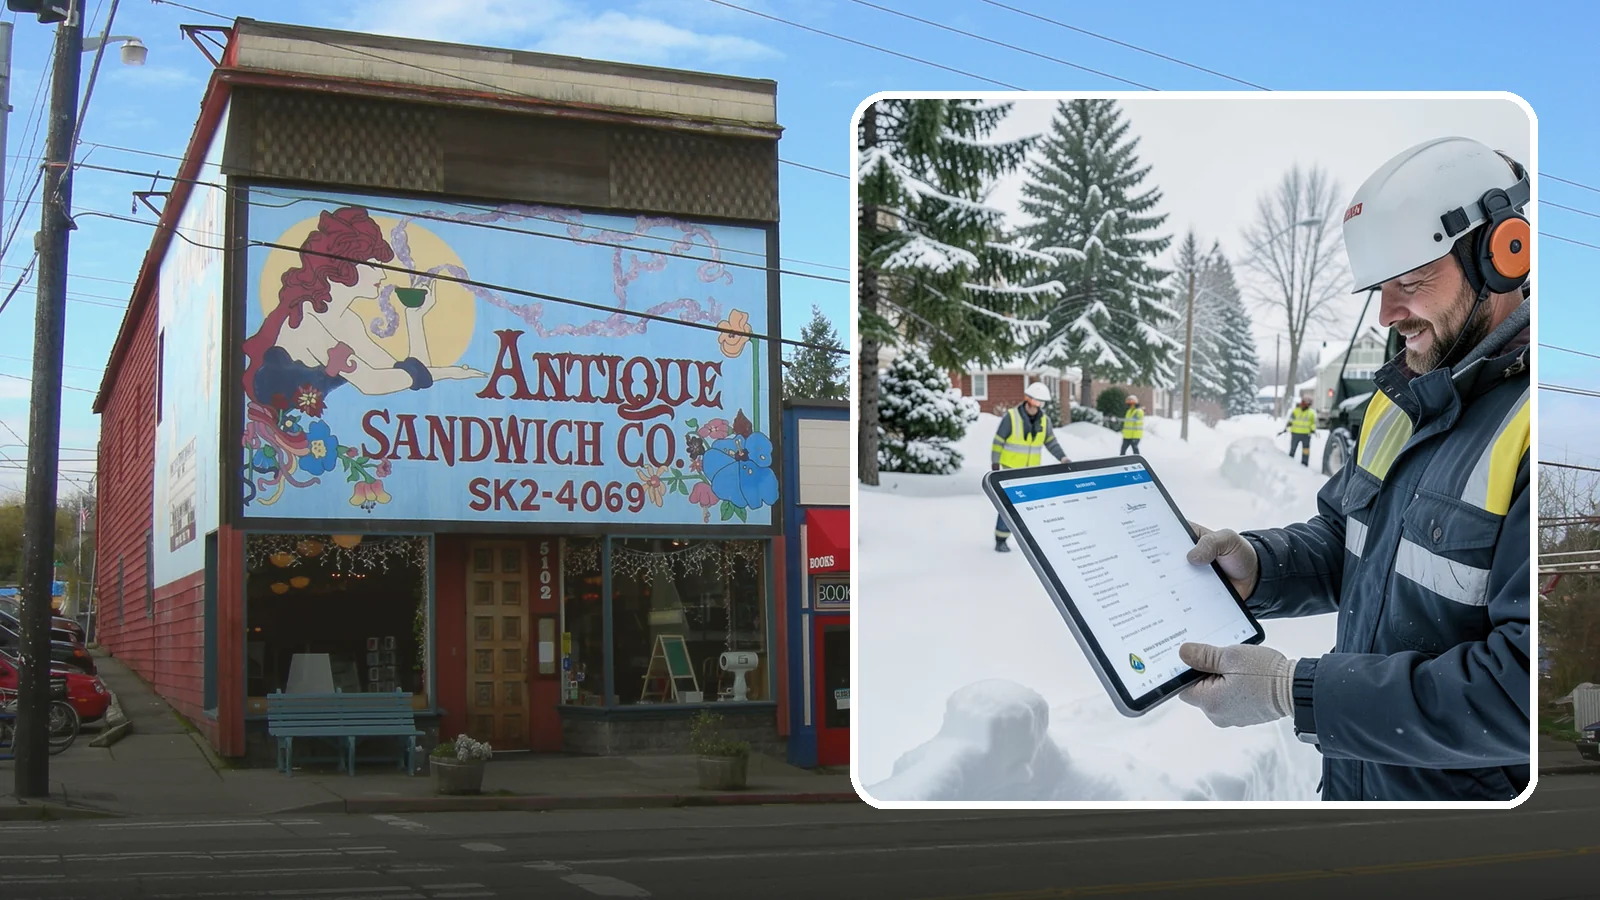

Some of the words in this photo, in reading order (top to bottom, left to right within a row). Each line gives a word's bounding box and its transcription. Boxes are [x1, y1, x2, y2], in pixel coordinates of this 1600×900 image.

[475, 329, 723, 421] ANTIQUE
[361, 408, 604, 467] SANDWICH
[617, 421, 685, 469] CO.
[468, 476, 645, 513] SK2-4069
[540, 541, 551, 600] 5102
[809, 555, 835, 569] BOOKS
